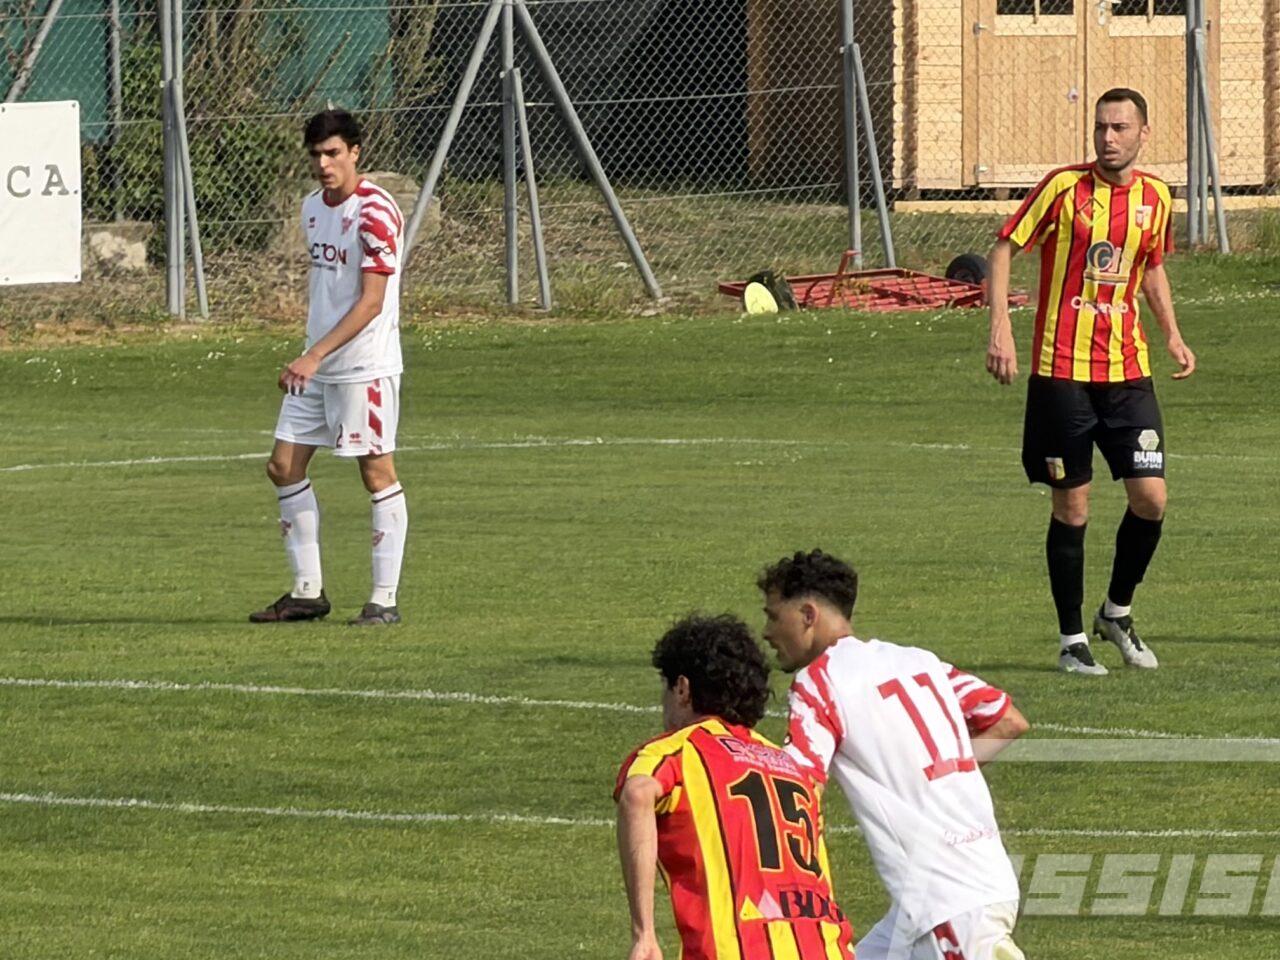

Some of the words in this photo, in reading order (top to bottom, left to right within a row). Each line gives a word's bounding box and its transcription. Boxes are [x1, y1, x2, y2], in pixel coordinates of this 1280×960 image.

[309, 242, 347, 265] CTON
[877, 672, 978, 781] 11
[726, 767, 823, 880] 15
